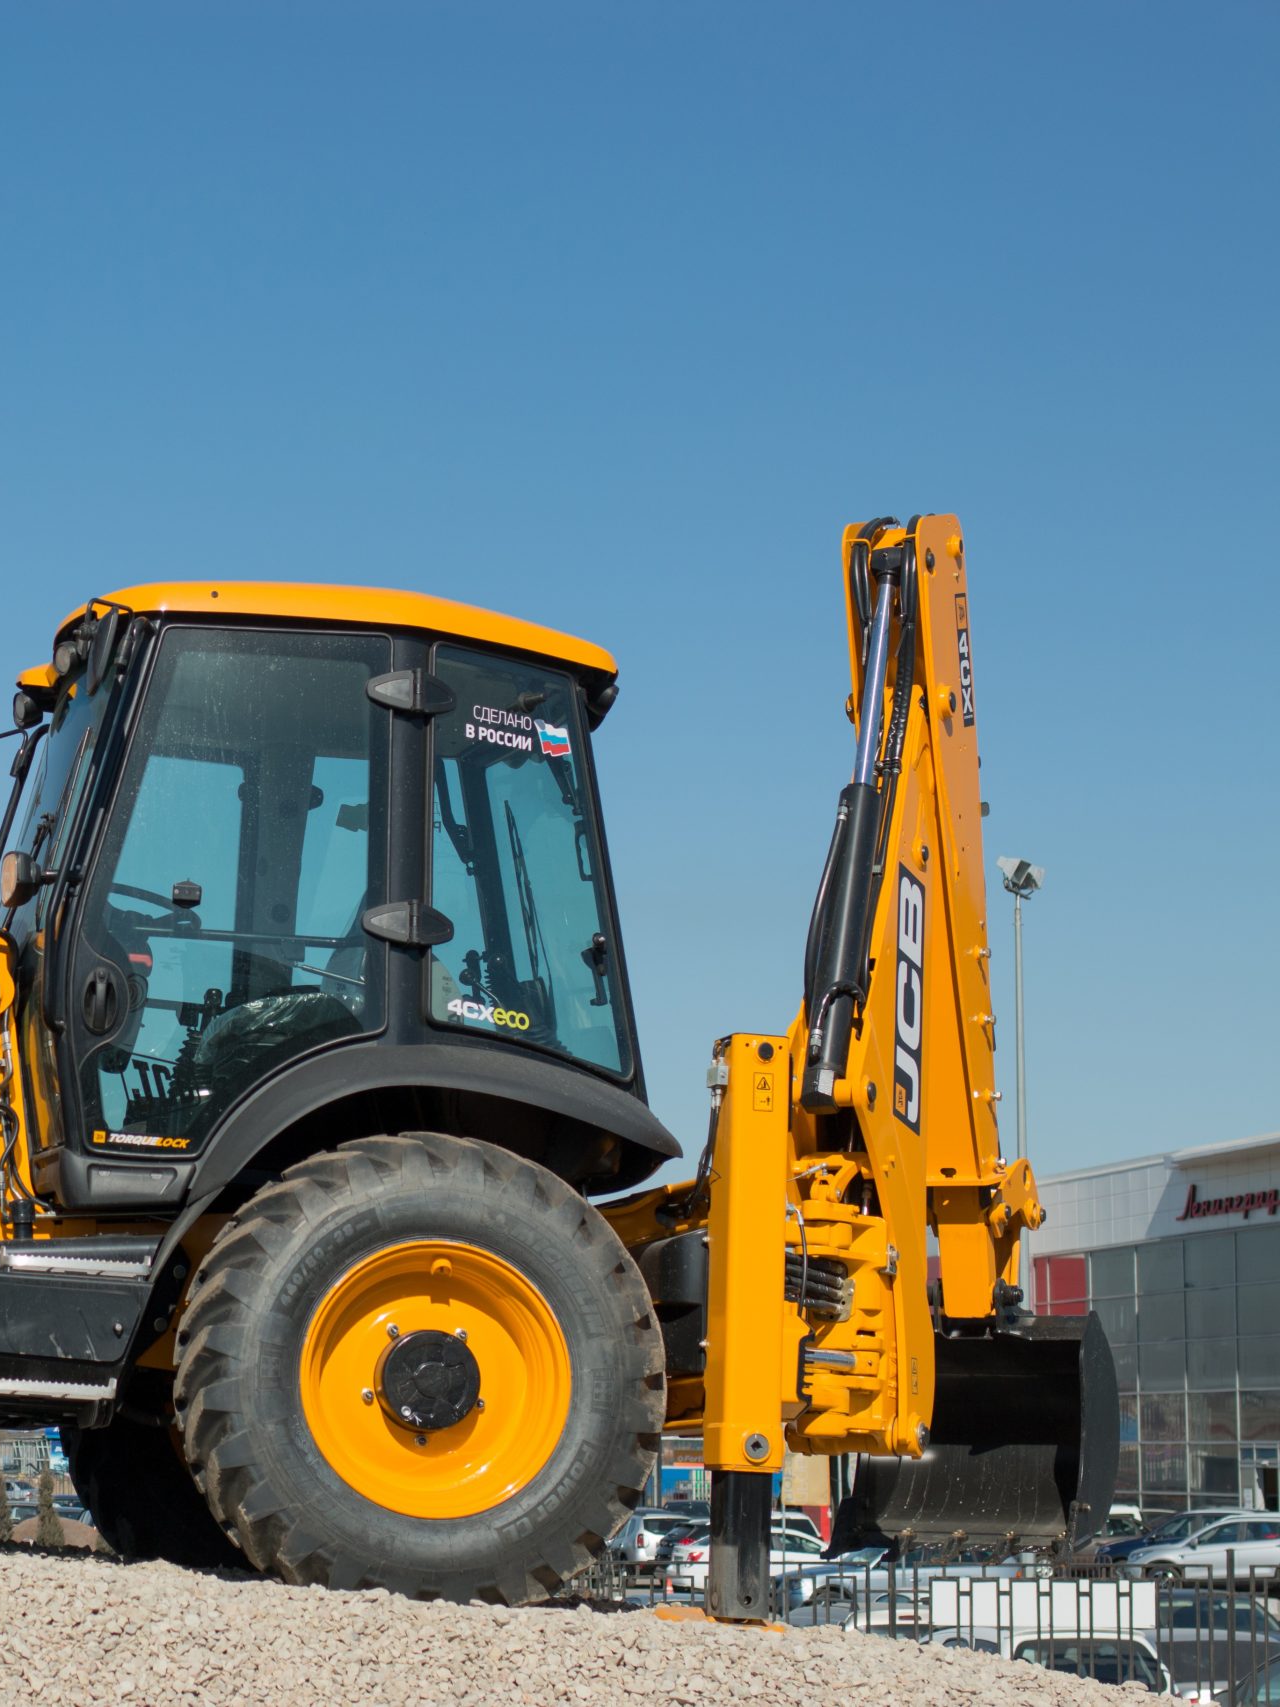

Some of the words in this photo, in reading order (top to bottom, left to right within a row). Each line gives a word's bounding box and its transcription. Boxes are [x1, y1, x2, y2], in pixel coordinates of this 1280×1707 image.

[959, 632, 973, 713] 4CX
[465, 723, 475, 738] В
[478, 727, 532, 751] РОССИИ
[473, 705, 532, 730] СДЕЛАНО
[896, 876, 923, 1124] JCB
[109, 1133, 190, 1148] TORQUELOCK
[511, 1223, 606, 1336] MICHELIN
